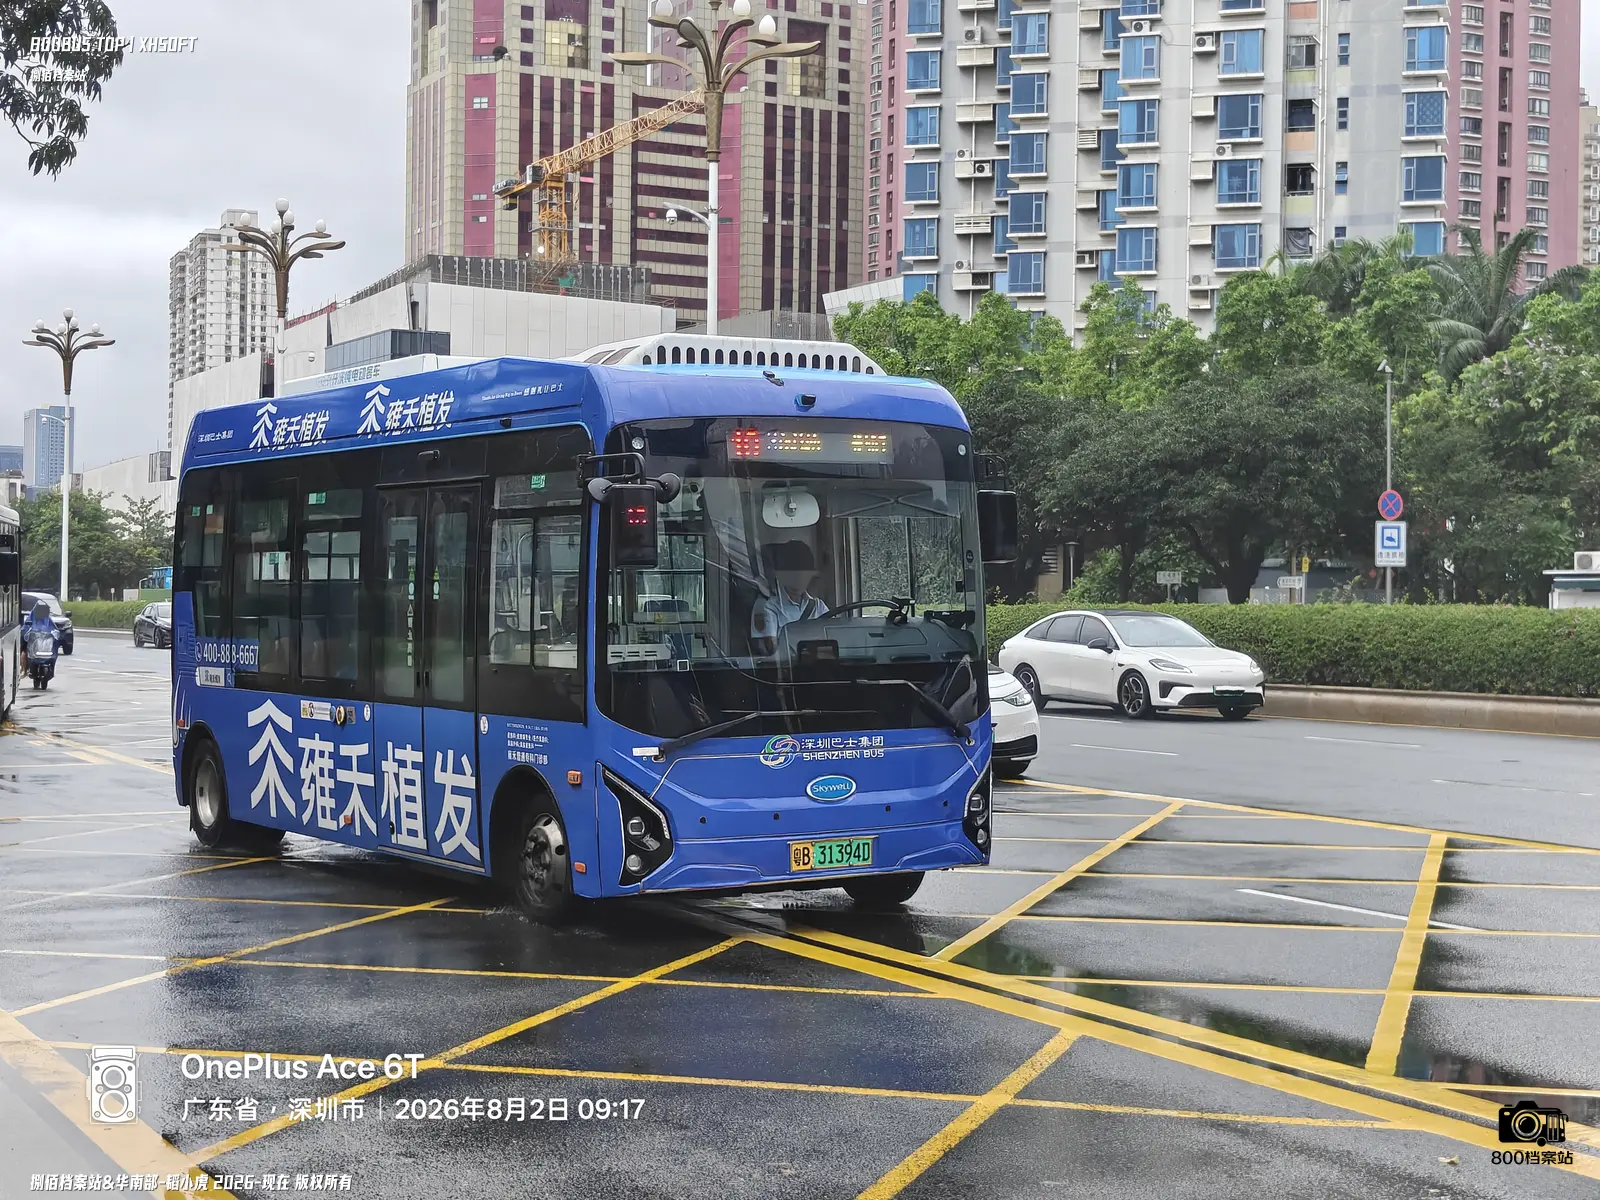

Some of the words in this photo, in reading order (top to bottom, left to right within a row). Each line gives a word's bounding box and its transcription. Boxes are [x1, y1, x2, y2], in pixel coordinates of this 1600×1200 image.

[203, 642, 259, 665] 400-888-6667
[802, 736, 884, 749] 深圳巴士集团
[803, 751, 860, 761] SHENZHEN
[865, 749, 884, 758] BUS
[298, 733, 482, 861] 雍禾植发
